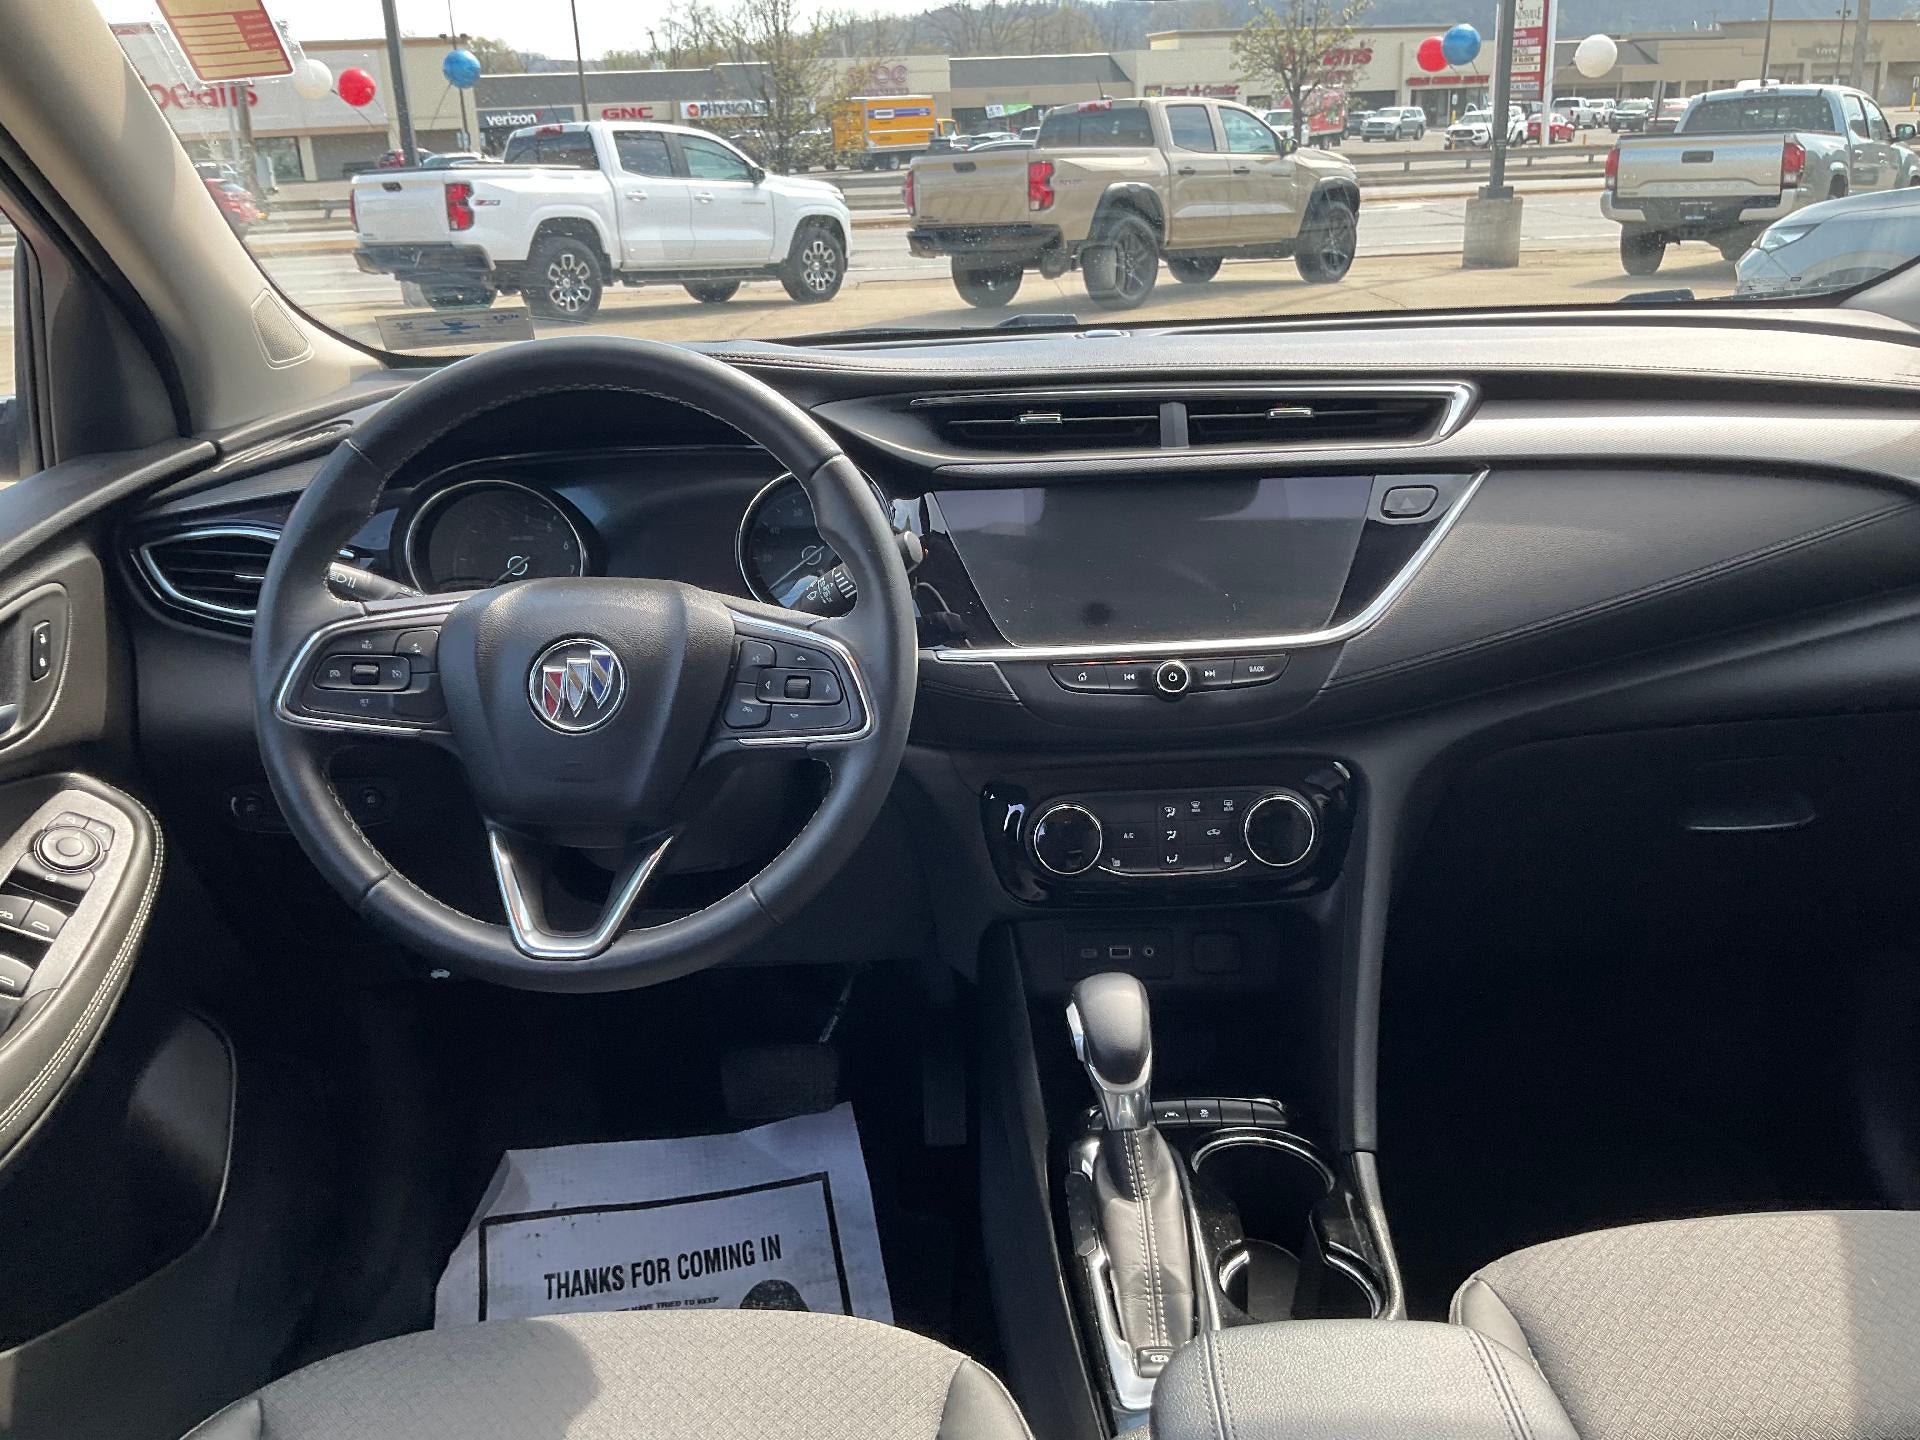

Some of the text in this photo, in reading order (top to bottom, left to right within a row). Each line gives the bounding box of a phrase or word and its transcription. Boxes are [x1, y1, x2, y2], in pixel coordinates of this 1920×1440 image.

[486, 111, 538, 127] verizon
[602, 107, 653, 119] GNC
[1248, 665, 1265, 673] BACK
[544, 1234, 781, 1300] THANKS FOR COMING IN
[656, 1300, 682, 1309] TRIED
